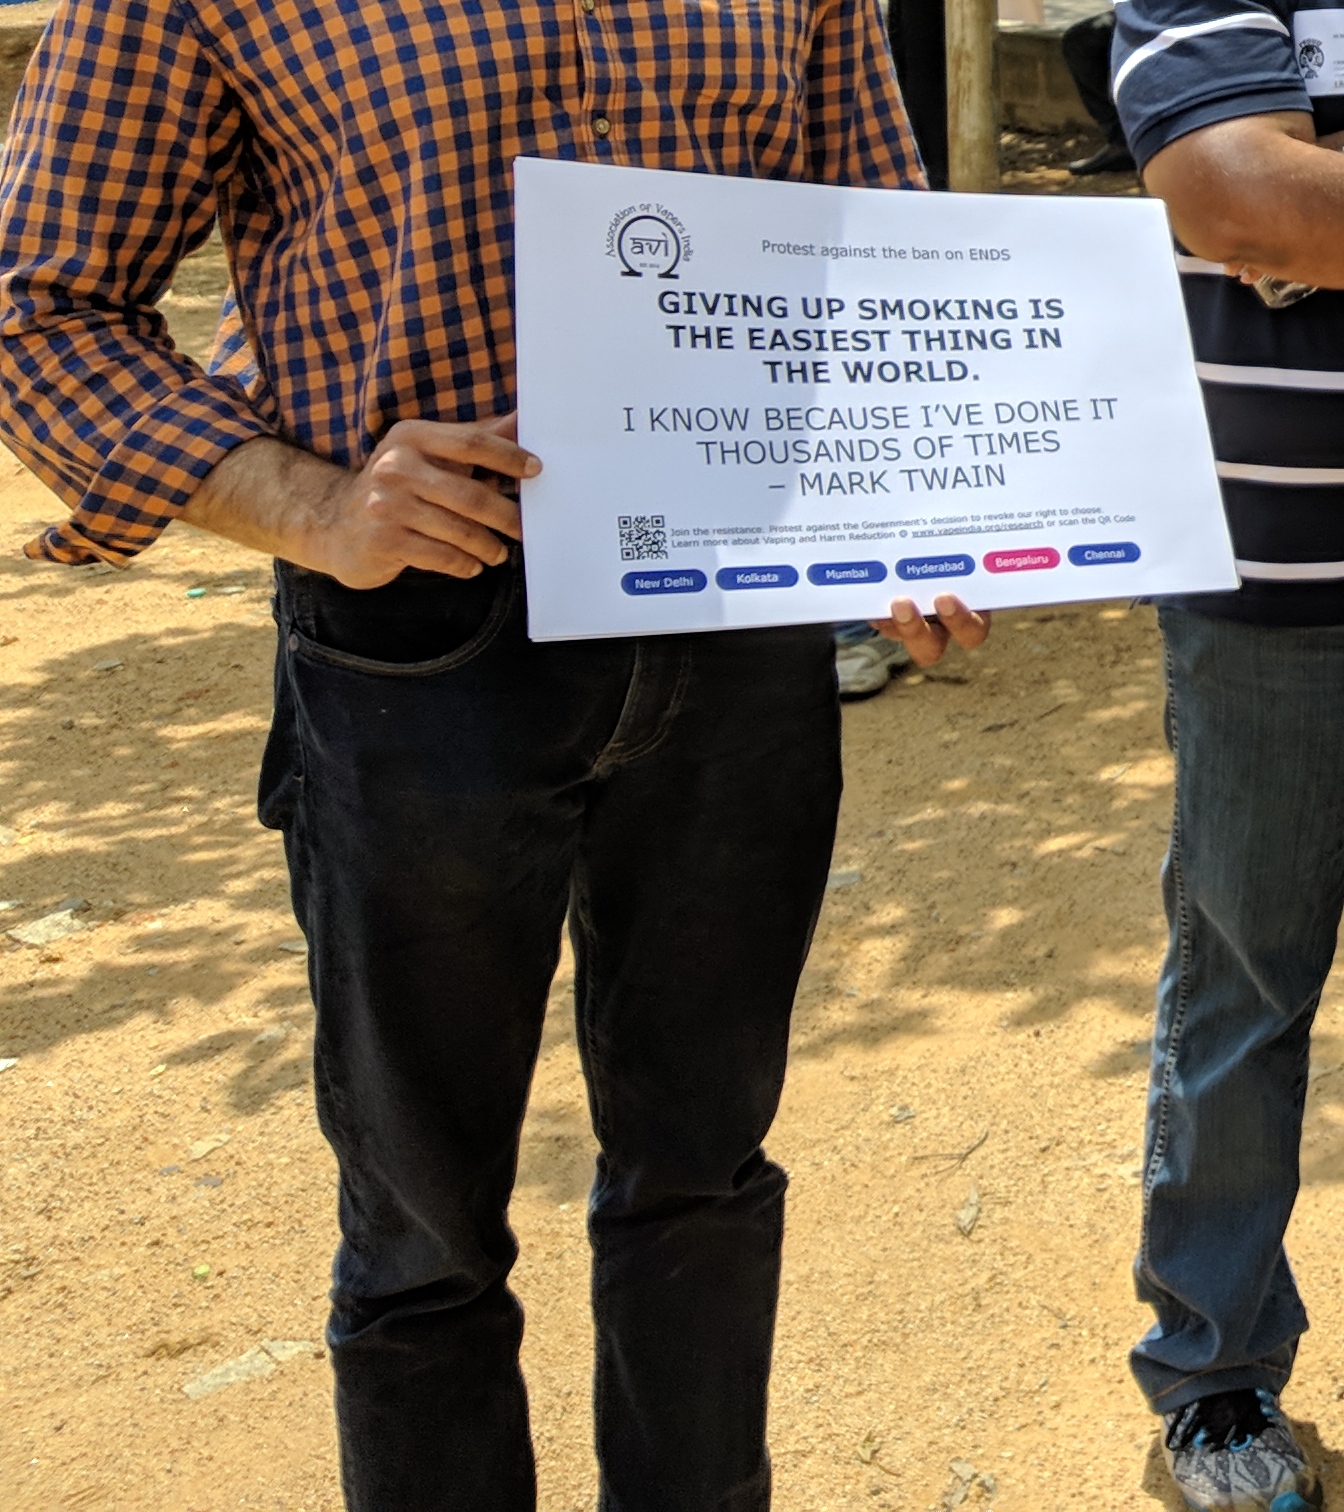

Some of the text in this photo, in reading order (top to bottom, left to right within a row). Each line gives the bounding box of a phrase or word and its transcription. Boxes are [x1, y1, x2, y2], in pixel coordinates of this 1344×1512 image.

[605, 204, 693, 261] Association of Vapers India
[762, 239, 1011, 261] Protest against the ban on ENDS
[658, 290, 1064, 321] GIVING UP SMOKING IS
[665, 324, 1062, 352] THE EASIEST THING IN
[762, 360, 979, 384] THE WORLD.
[622, 397, 1117, 432] I KNOW BECAUSE I'VE DONE IT
[695, 429, 1060, 465] THOUSANDS OF TIMES
[799, 469, 890, 496] MARK
[898, 463, 1005, 492] TWAIN
[995, 556, 1048, 568] Bengaluru
[1084, 549, 1125, 560] Chennai
[736, 573, 779, 584] Kolkata
[825, 569, 869, 579] Mumbai
[906, 561, 964, 576] Hyderabad
[635, 576, 694, 589] New Delhi
